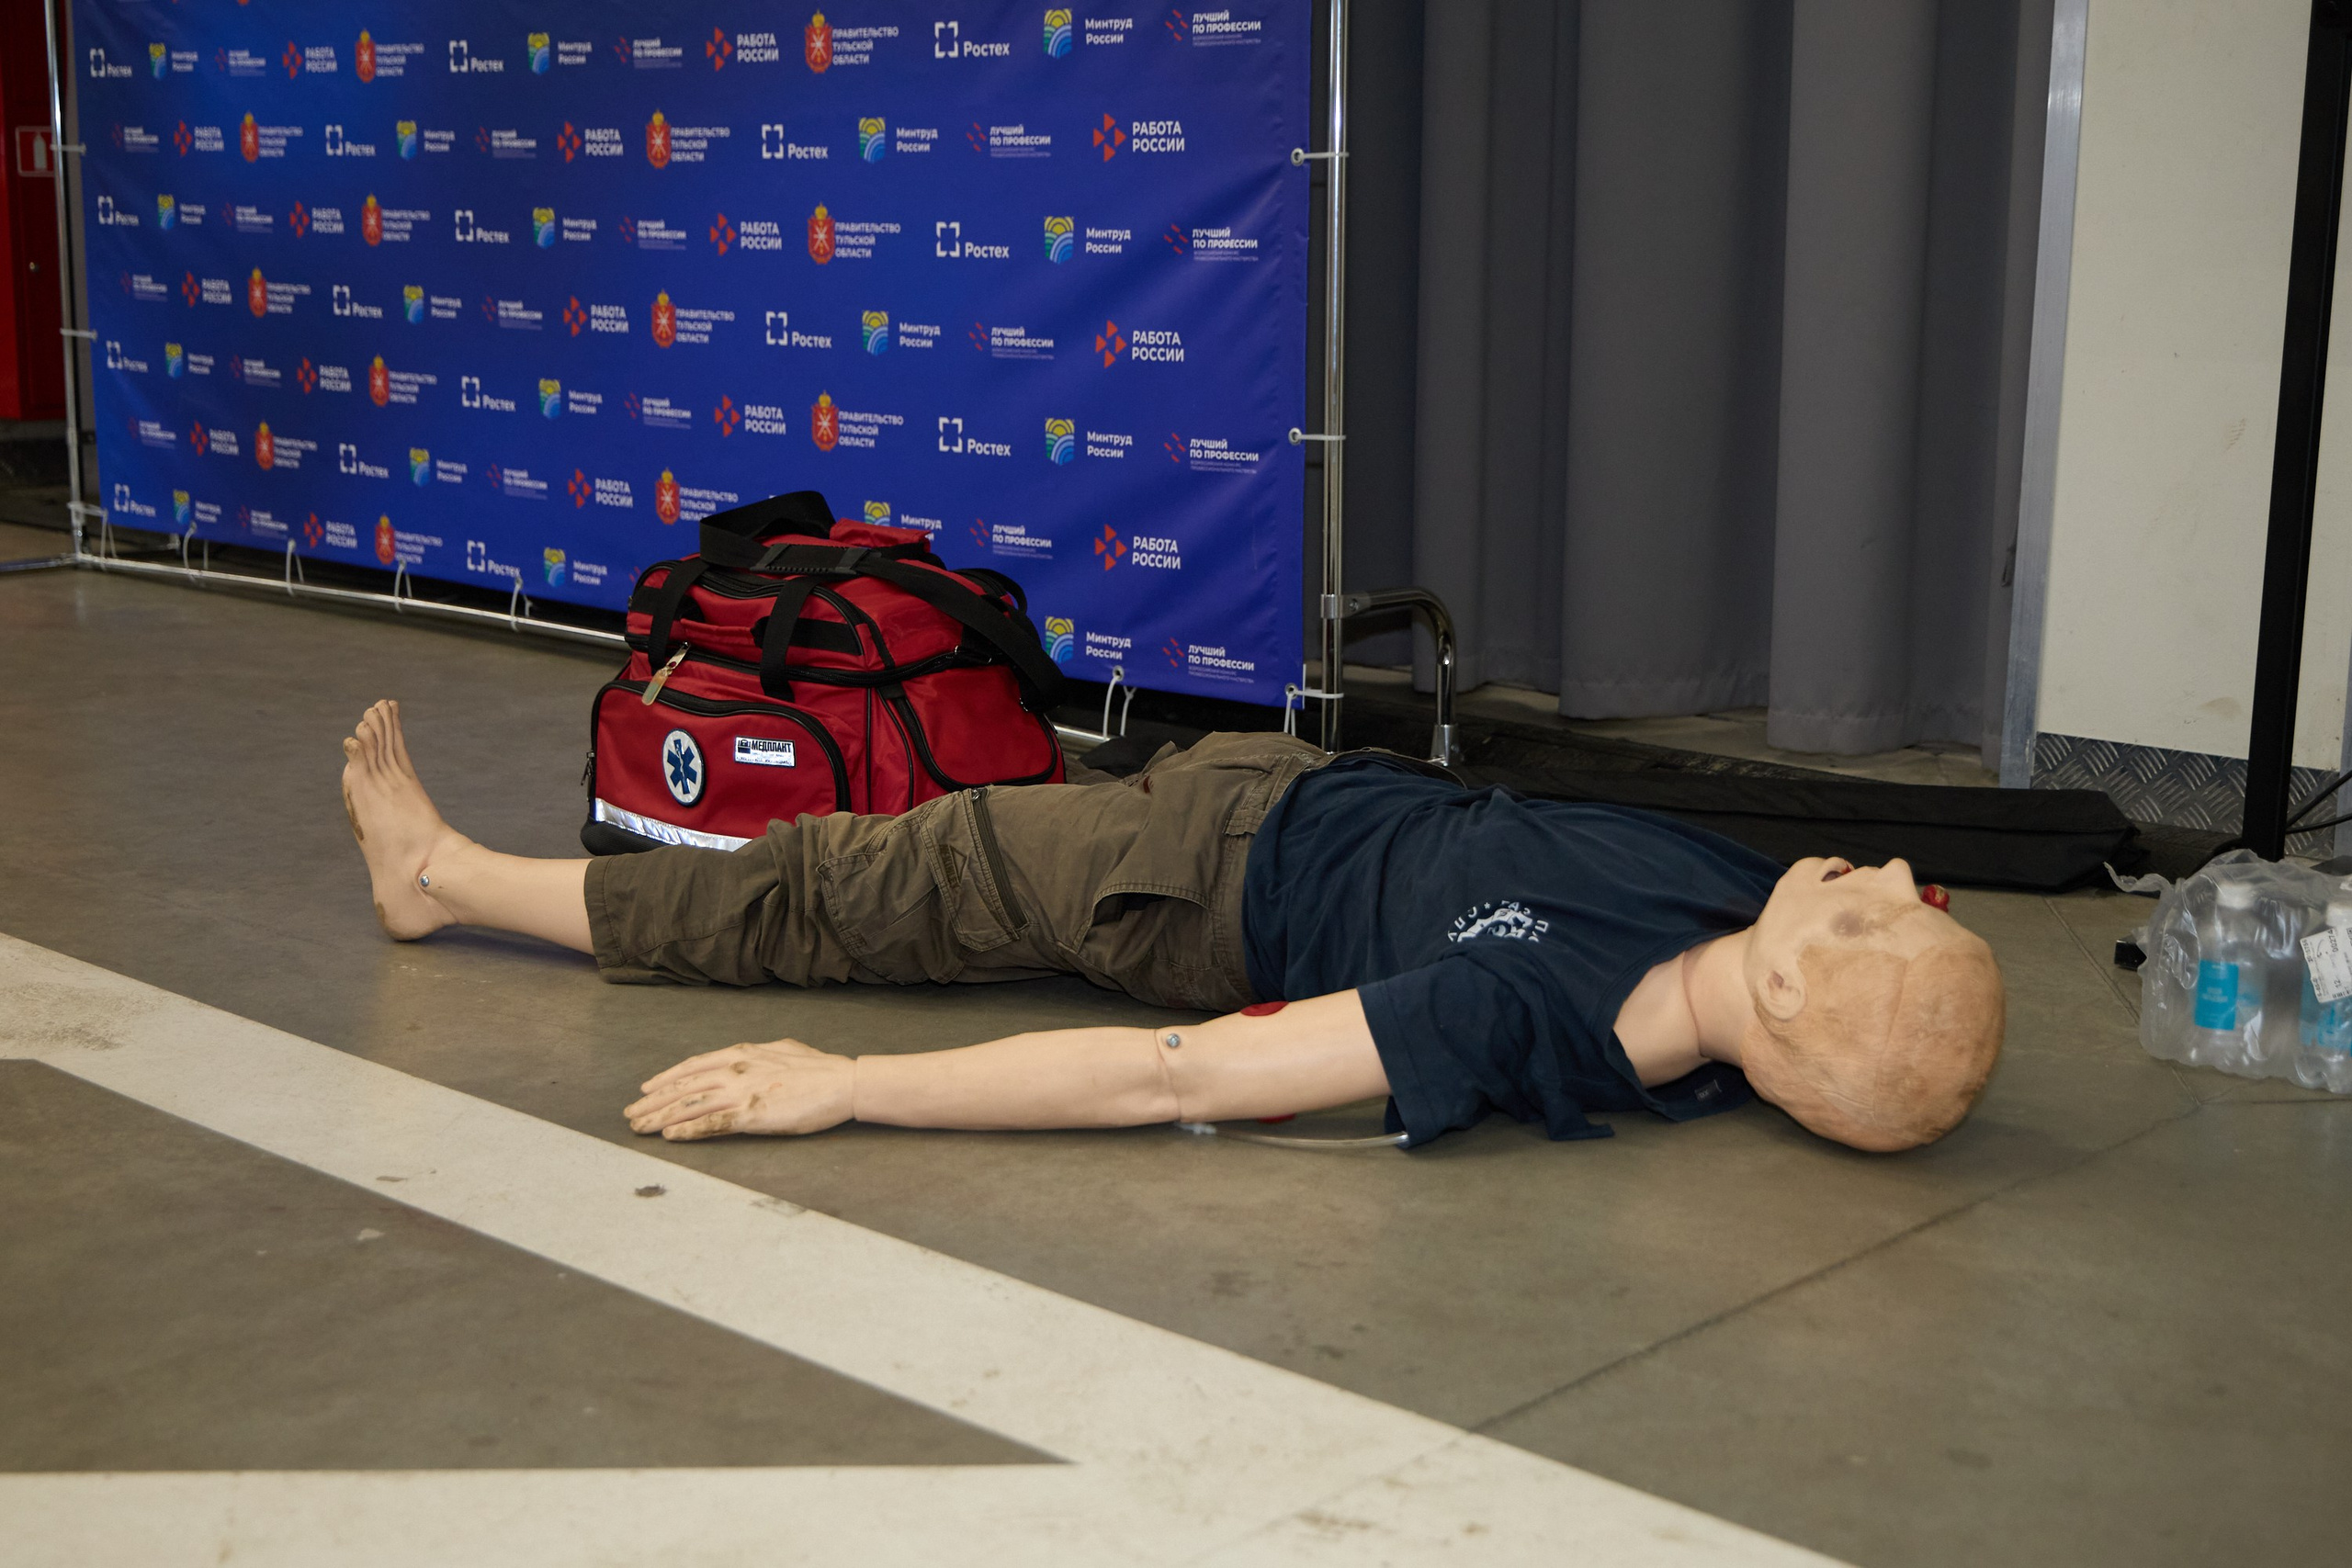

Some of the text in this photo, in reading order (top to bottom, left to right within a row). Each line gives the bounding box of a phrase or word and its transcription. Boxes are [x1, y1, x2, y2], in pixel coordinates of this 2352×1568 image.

[1193, 10, 1229, 23] ЛУЧШИЙ
[1086, 18, 1133, 30] Минтруд
[1193, 21, 1261, 33] ПО ПРОФЕССИИ
[832, 27, 899, 39] ПРАВИТЕЛЬСТВО
[1086, 33, 1124, 44] России
[737, 33, 775, 47] РАБОТА
[832, 39, 873, 51] ТУЛЬСКОЙ
[737, 48, 779, 62] РОССИИ
[964, 41, 1009, 57] Ростех
[470, 57, 503, 72] Ростех
[832, 54, 869, 65] ОБЛАСТИ
[897, 128, 938, 140] Минтруд
[990, 125, 1023, 135] ЛУЧШИЙ
[1133, 121, 1182, 135] РАБОТА
[585, 129, 620, 141] РАБОТА
[990, 136, 1051, 145] ПО ПРОФЕССИИ
[585, 143, 623, 156] РОССИИ
[788, 143, 828, 159] Ростех
[897, 141, 930, 152] России
[1133, 138, 1184, 152] РОССИИ
[741, 221, 779, 235] РАБОТА
[834, 222, 900, 233] ПРАВИТЕЛЬСТВО
[1193, 227, 1230, 238] ЛУЧШИЙ
[476, 228, 509, 243] Ростех
[835, 234, 875, 245] ТУЛЬСКОЙ
[1086, 228, 1131, 241] Минтруд
[741, 236, 782, 250] РОССИИ
[1086, 243, 1122, 254] России
[1193, 239, 1257, 248] ПО ПРОФЕССИИ
[835, 248, 871, 258] ОБЛАСТИ
[965, 243, 1009, 258] Ростех
[591, 305, 626, 318] РАБОТА
[591, 318, 628, 333] РОССИИ
[899, 322, 941, 336] Минтруд
[991, 327, 1024, 336] ЛУЧШИЙ
[792, 332, 831, 347] Ростех
[899, 336, 933, 347] России
[991, 337, 1053, 347] ПО ПРОФЕССИИ
[1133, 331, 1181, 345] РАБОТА
[1132, 347, 1183, 362] РОССИИ
[482, 395, 514, 412] Ростех
[745, 405, 783, 419] РАБОТА
[838, 412, 904, 425] ПРАВИТЕЛЬСТВО
[745, 419, 786, 434] РОССИИ
[839, 423, 878, 435] ТУЛЬСКОЙ
[839, 435, 875, 447] ОБЛАСТИ
[1088, 432, 1132, 446] Минтруд
[1190, 439, 1227, 449] ЛУЧШИЙ
[967, 439, 1011, 456] Ростех
[1088, 446, 1123, 457] России
[1190, 449, 1259, 461] ПО ПРОФЕССИИ
[595, 479, 630, 493] РАБОТА
[595, 491, 633, 507] РОССИИ
[901, 514, 942, 529] Минтруд
[992, 525, 1025, 536] ЛУЧШИЙ
[992, 535, 1051, 547] ПО ПРОФЕССИИ
[1134, 536, 1178, 553] РАБОТА
[1132, 552, 1180, 569] РОССИИ
[1086, 632, 1131, 649] Минтруд
[1086, 646, 1122, 660] России
[1189, 645, 1226, 657] ЛУЧШИЙ
[1189, 655, 1254, 671] ПО ПРОФЕССИИ
